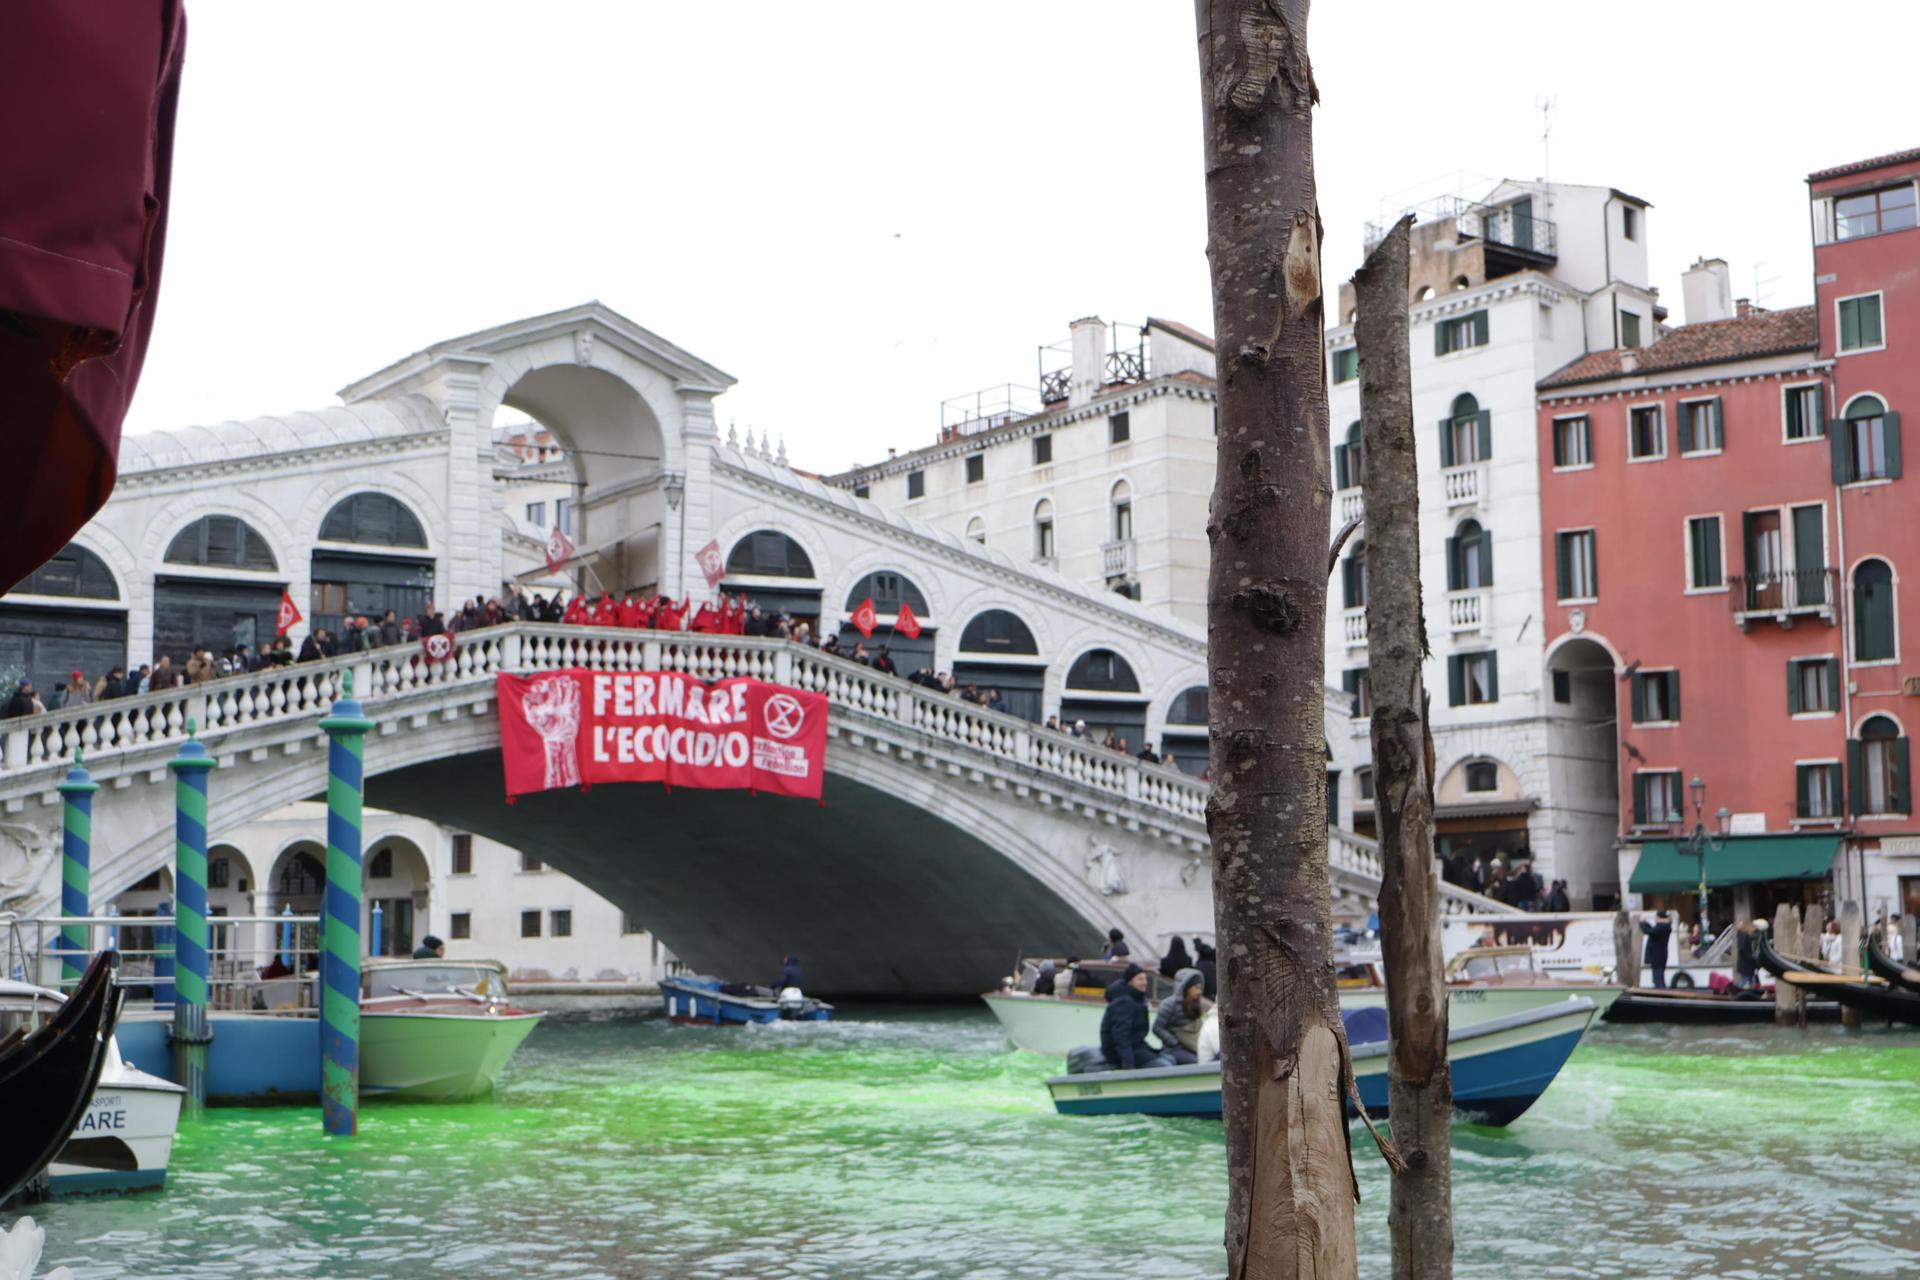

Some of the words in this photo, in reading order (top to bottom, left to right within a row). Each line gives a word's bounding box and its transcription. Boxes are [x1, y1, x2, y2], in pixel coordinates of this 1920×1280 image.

[593, 675, 748, 724] FERMARE
[594, 724, 749, 767] L'ECOCIDIO
[75, 1110, 126, 1131] ARE
